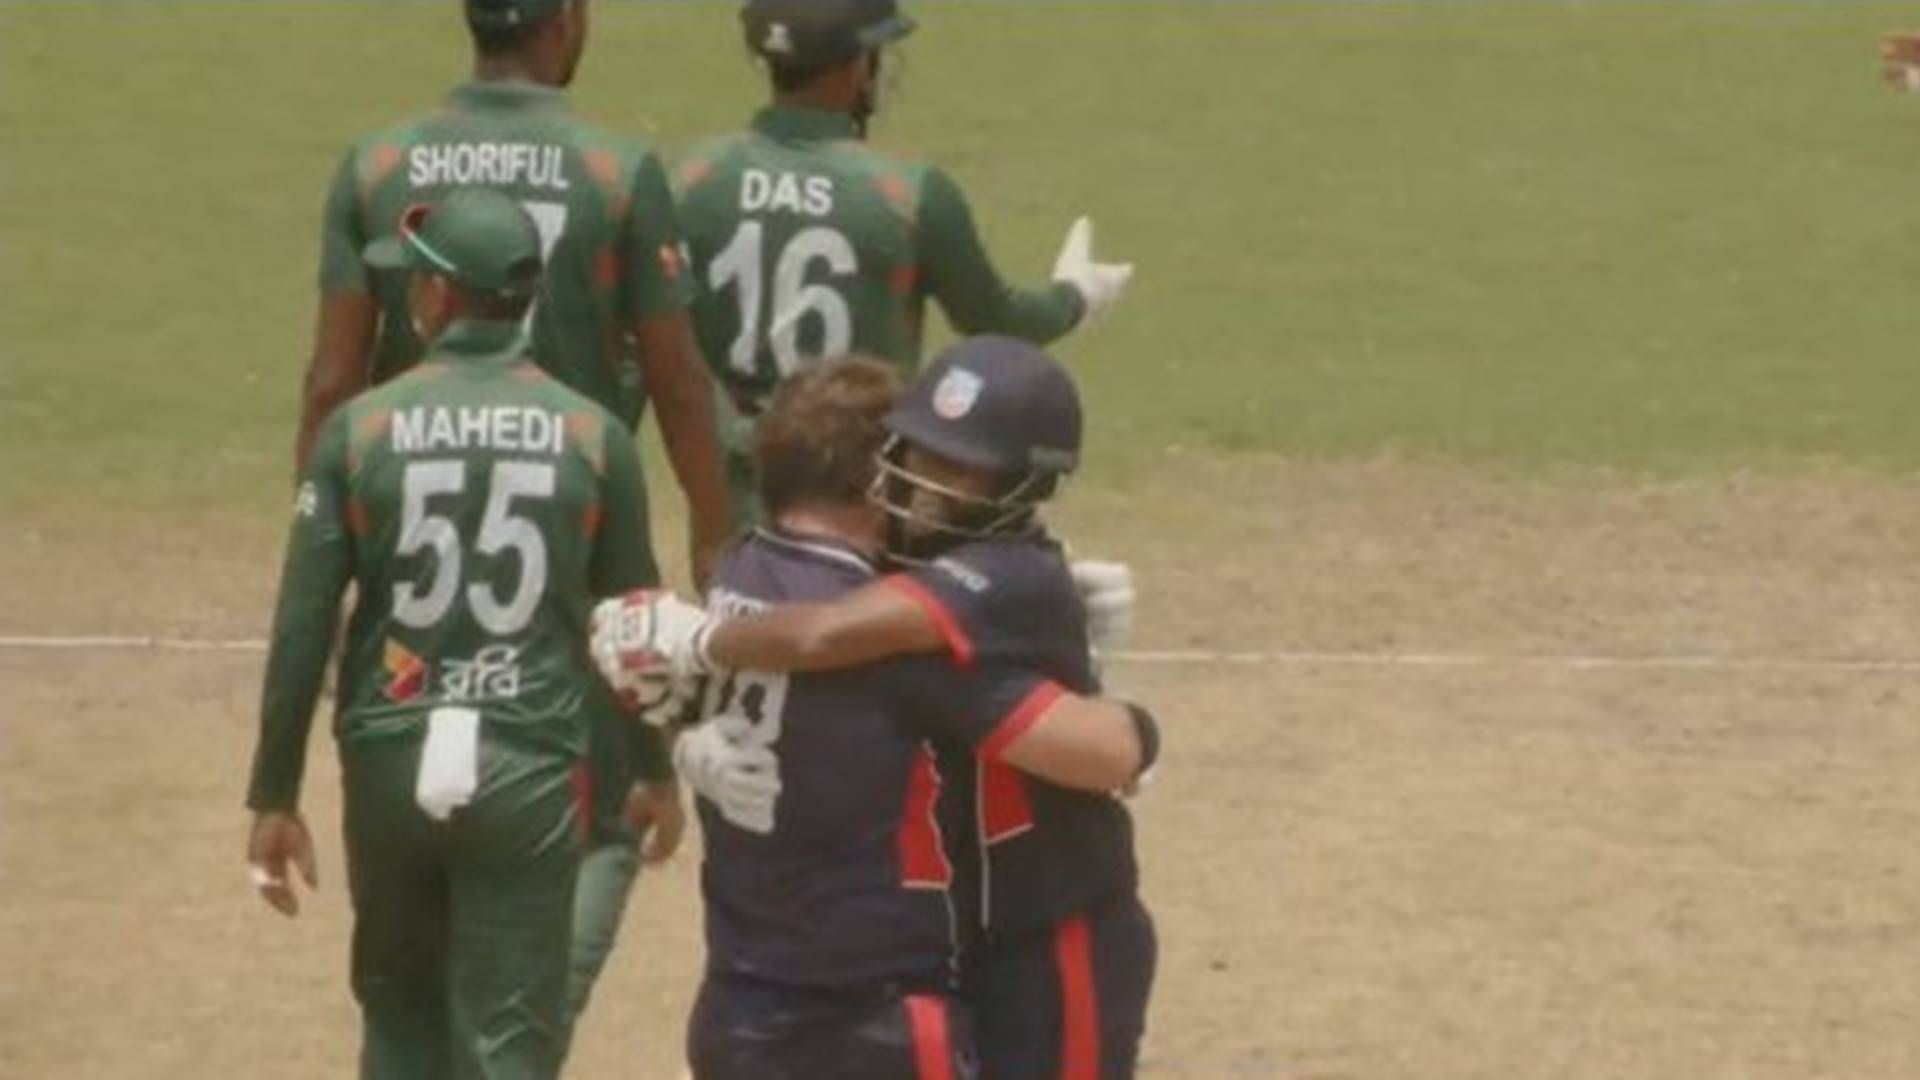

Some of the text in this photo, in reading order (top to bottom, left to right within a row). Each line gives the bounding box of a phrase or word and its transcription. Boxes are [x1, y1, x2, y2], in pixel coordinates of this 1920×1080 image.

[408, 143, 570, 189] SHORIFUL
[740, 168, 834, 216] DAS
[708, 219, 858, 379] 16
[391, 406, 564, 454] MAHEDI
[392, 459, 556, 635] 55
